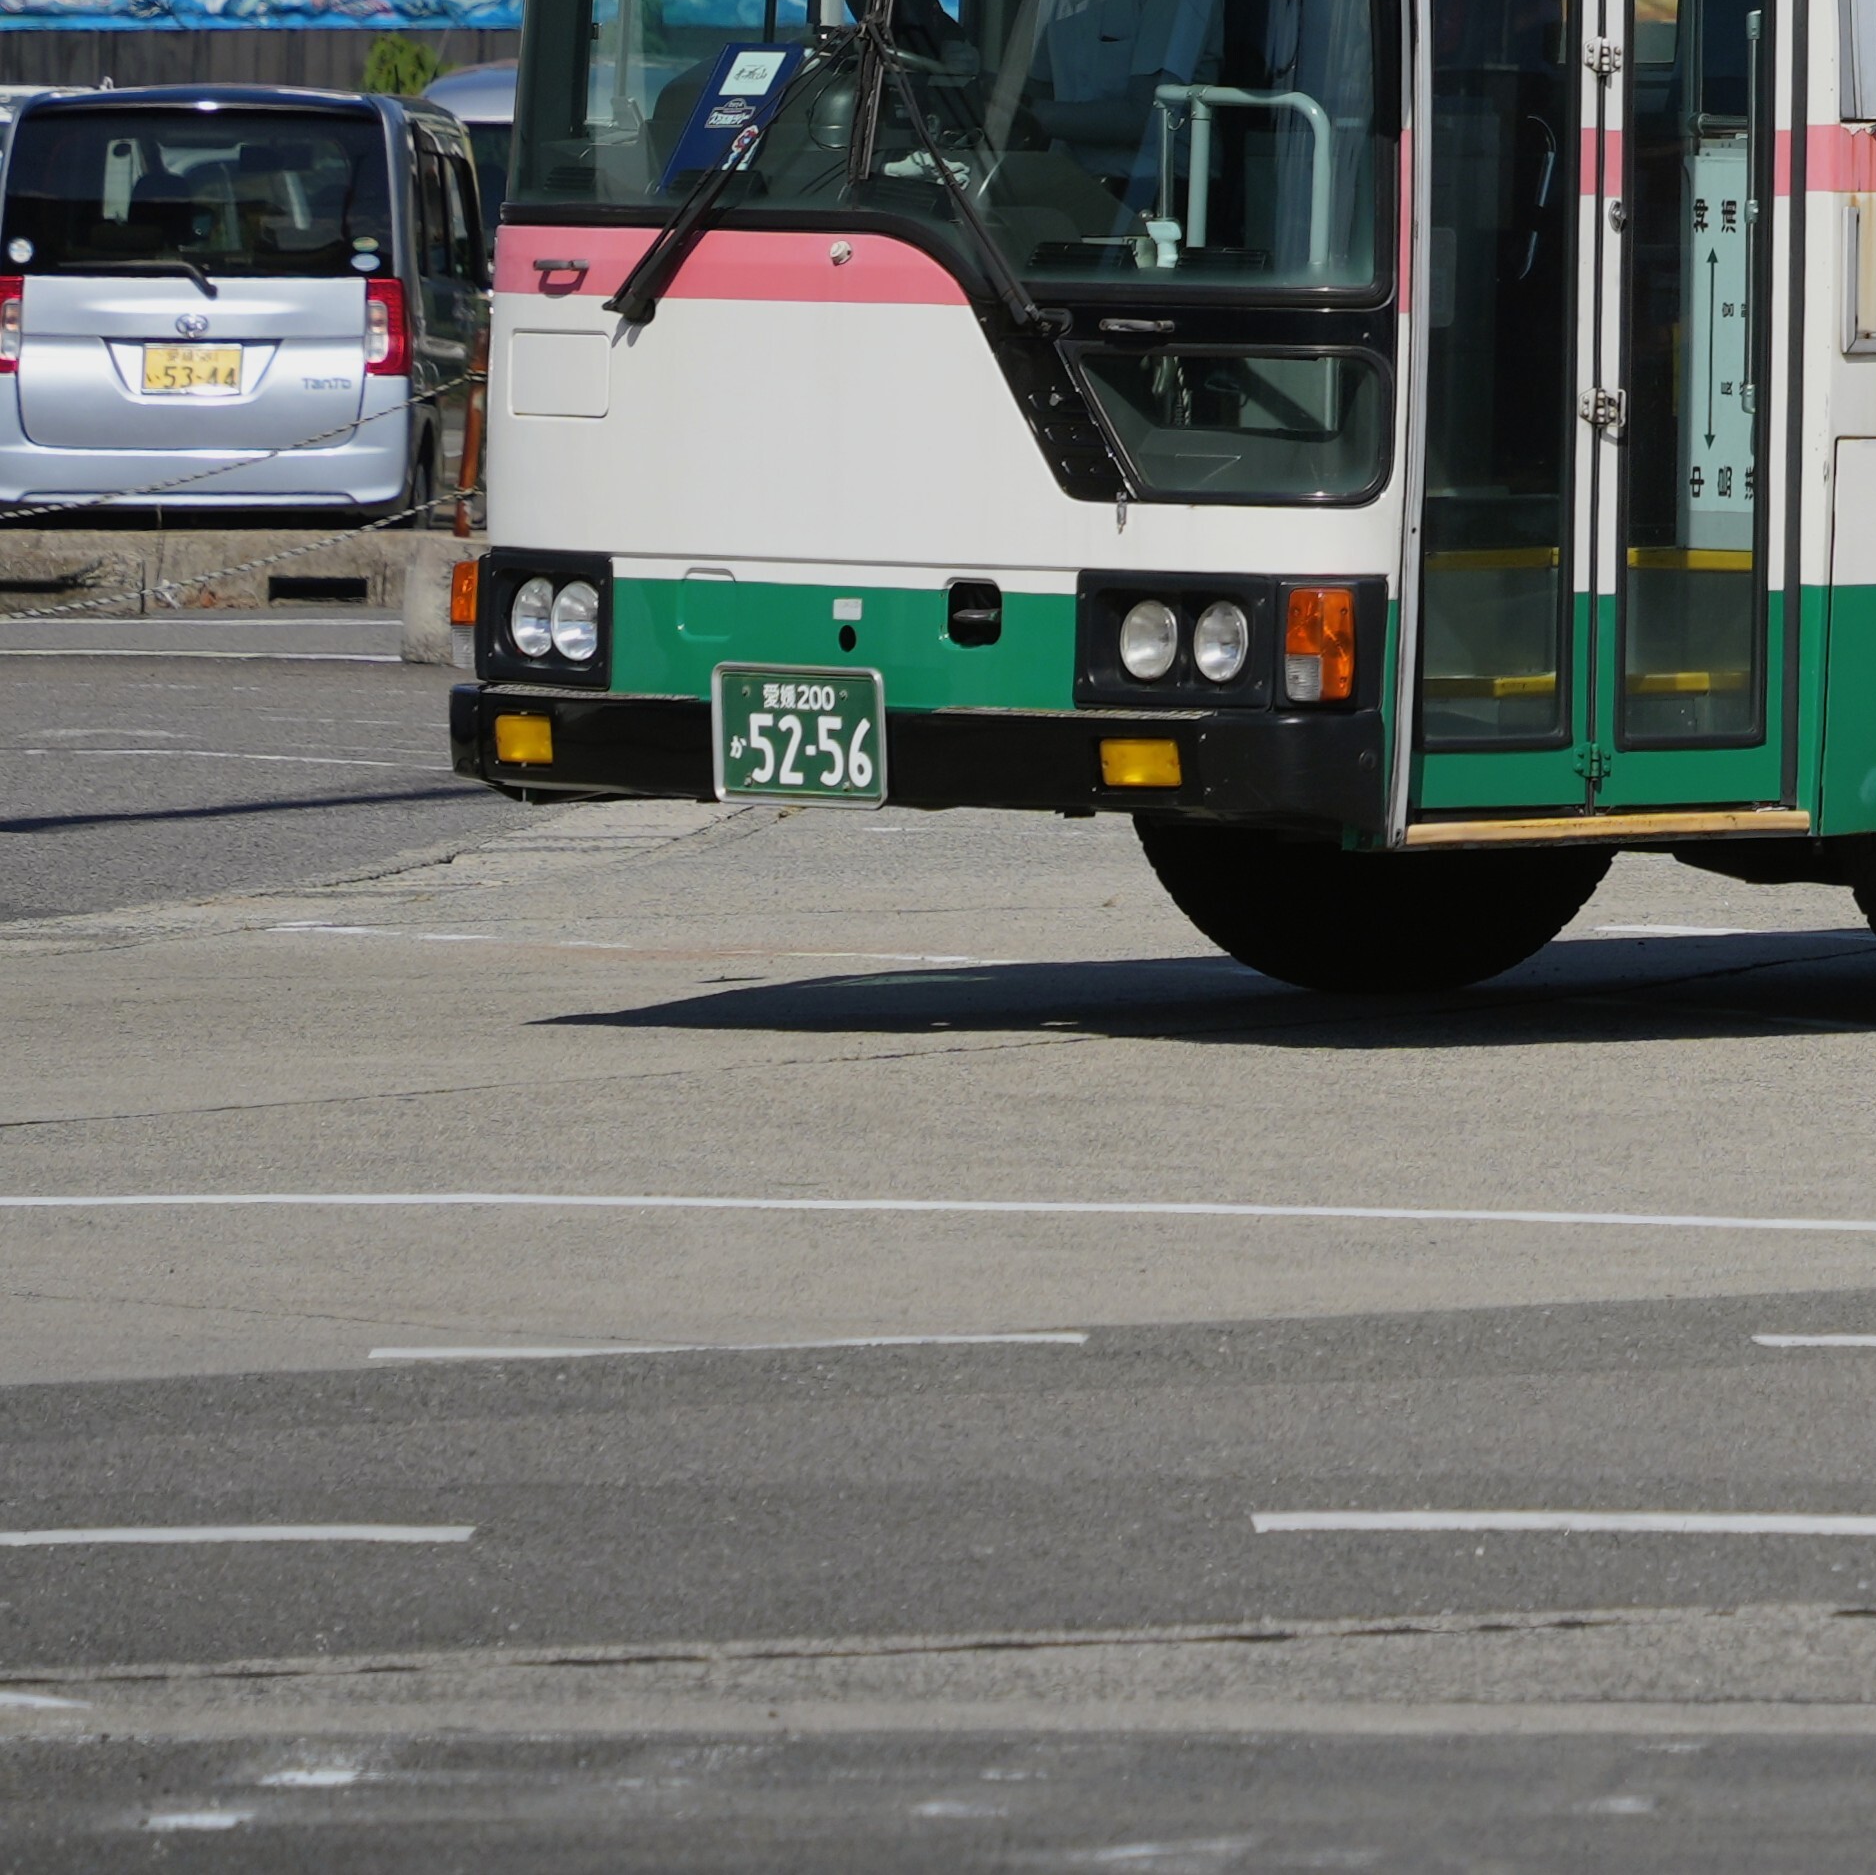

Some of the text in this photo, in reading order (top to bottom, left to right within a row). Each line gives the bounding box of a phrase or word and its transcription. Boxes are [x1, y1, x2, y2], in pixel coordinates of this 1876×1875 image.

[163, 365, 237, 389] 53-44
[729, 712, 874, 789] か 52-56
